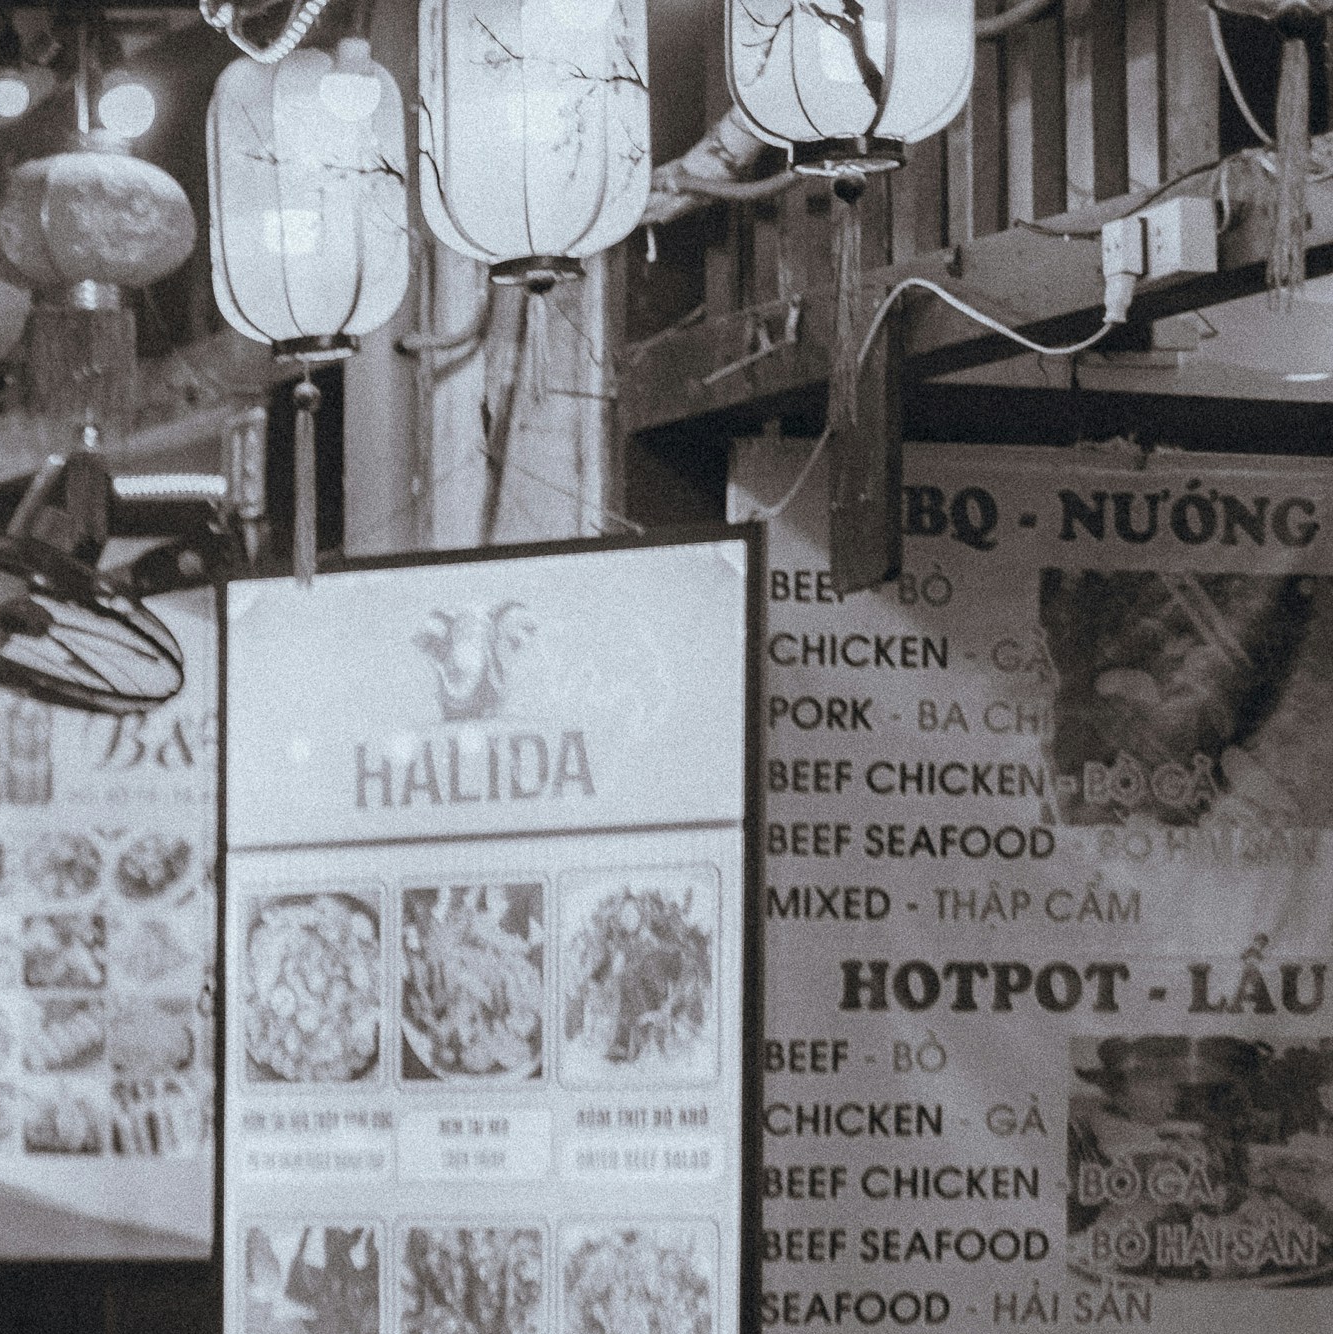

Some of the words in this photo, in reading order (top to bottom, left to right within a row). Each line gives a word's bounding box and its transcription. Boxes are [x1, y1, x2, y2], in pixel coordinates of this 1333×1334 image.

[903, 484, 999, 551] BQ
[1056, 477, 1322, 549] NƯỚNG
[770, 570, 844, 602] BEE
[769, 632, 948, 669] CHICKEN
[769, 695, 872, 732] PORK
[917, 699, 970, 733] BA
[354, 731, 596, 809] HALIDA
[768, 758, 852, 794] BEEF
[865, 760, 1045, 798] CHICKEN
[768, 822, 852, 857] BEEF
[865, 823, 1056, 860] SEAFOOD
[767, 885, 891, 921] MIXED
[839, 959, 1130, 1014] HOTPOT
[763, 1039, 848, 1073] BEEF
[762, 1102, 942, 1138] CHICKEN
[762, 1164, 847, 1200] BEEF
[861, 1165, 1039, 1201] CHICKEN
[762, 1227, 847, 1262] BEEF
[860, 1228, 1050, 1263] SEAFOOD
[761, 1290, 950, 1326] SEAFOOD
